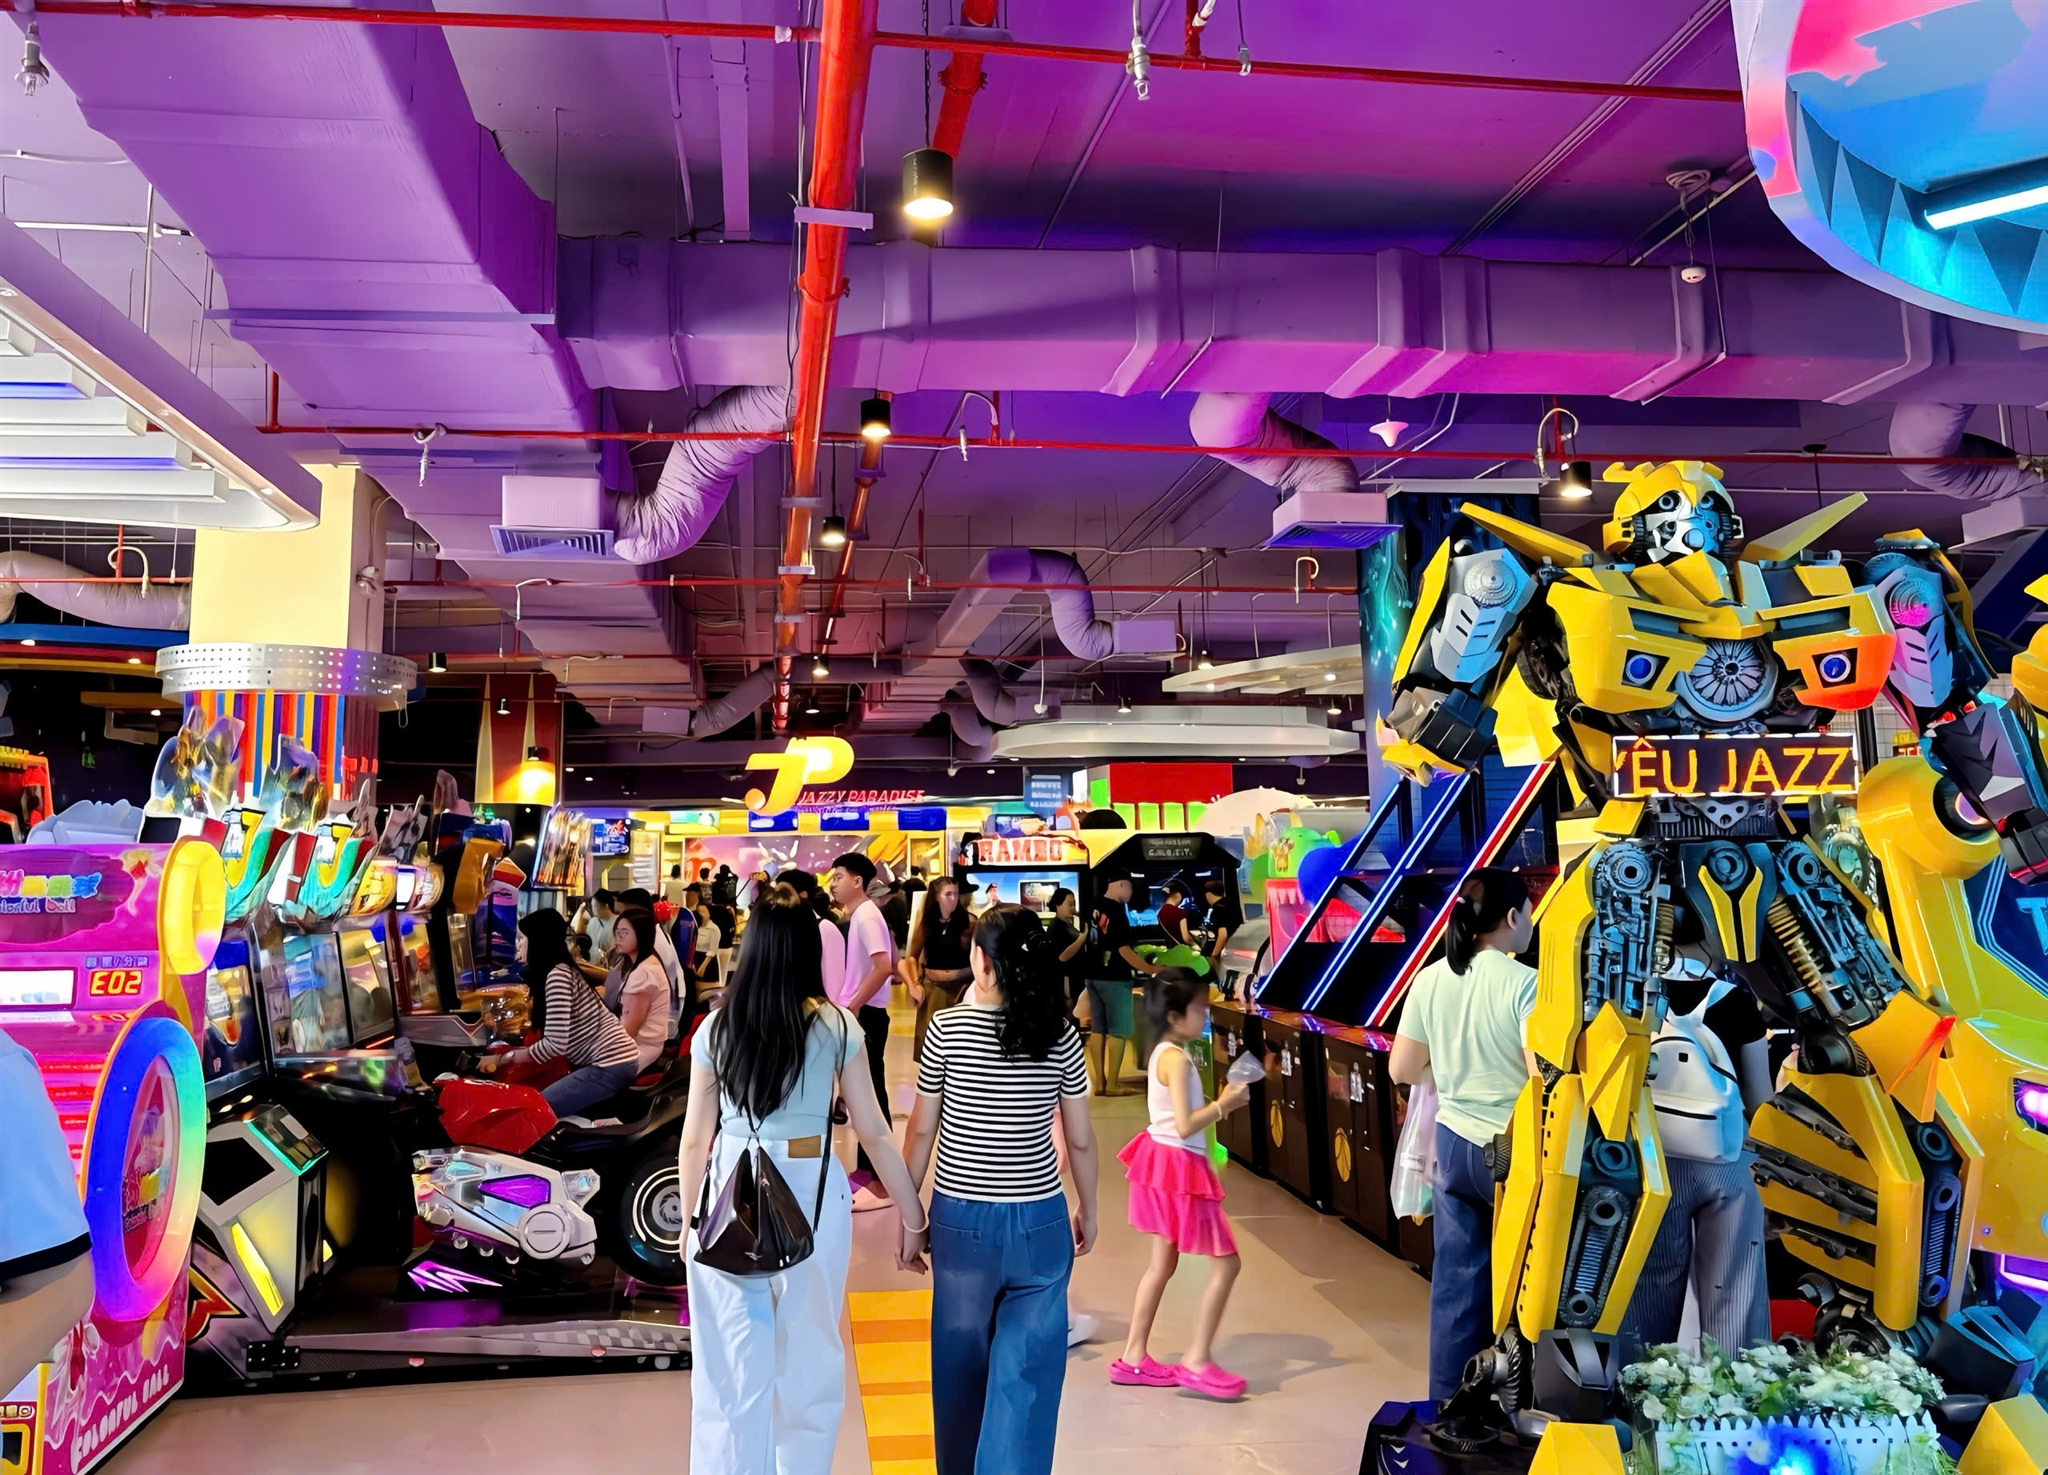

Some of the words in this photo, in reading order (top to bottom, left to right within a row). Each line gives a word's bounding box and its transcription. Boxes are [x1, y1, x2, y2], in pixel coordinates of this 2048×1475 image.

[1718, 747, 1853, 793] JAZZ
[799, 790, 847, 804] JAZZY
[847, 789, 926, 804] PARADISE
[979, 839, 1062, 862] RAMBO
[91, 971, 141, 995] E02
